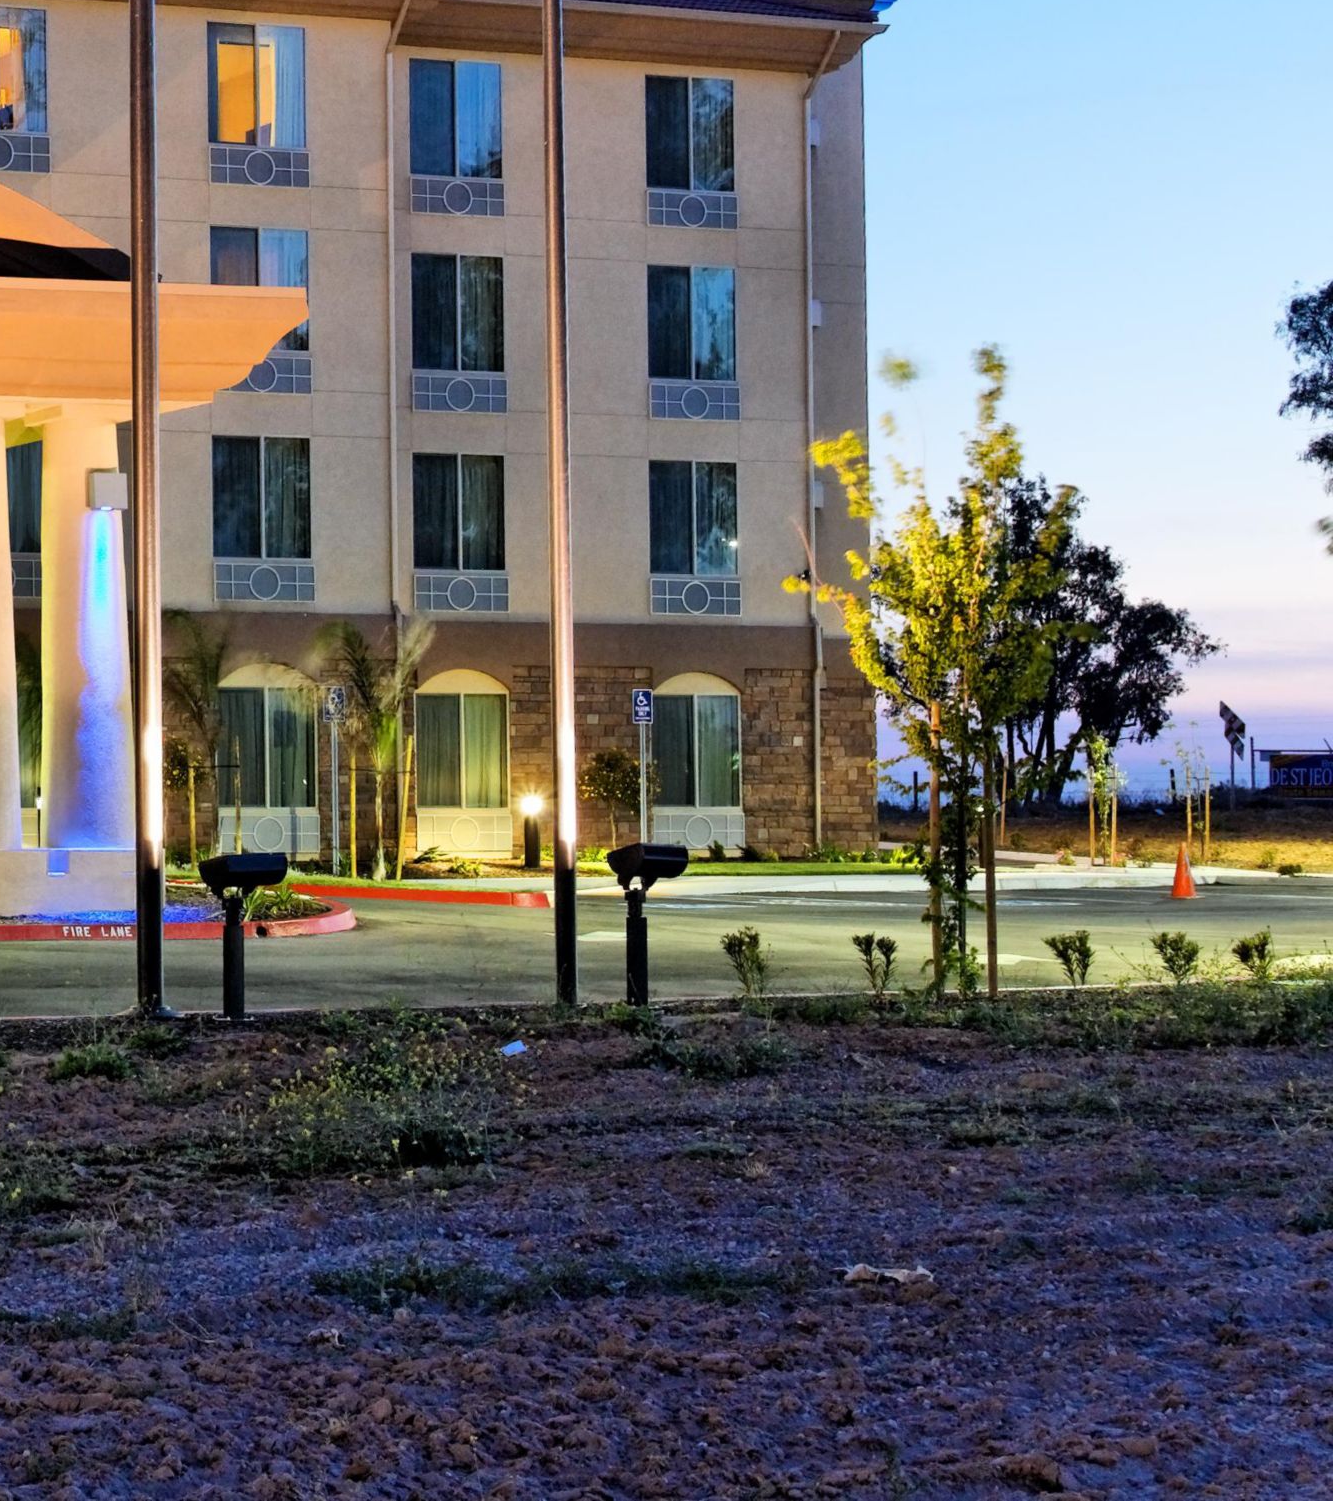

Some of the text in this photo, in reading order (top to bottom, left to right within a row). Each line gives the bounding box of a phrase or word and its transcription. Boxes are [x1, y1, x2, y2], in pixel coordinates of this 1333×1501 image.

[1271, 767, 1289, 786] DE
[1290, 767, 1307, 786] ST
[62, 926, 133, 937] FIRE LANE
